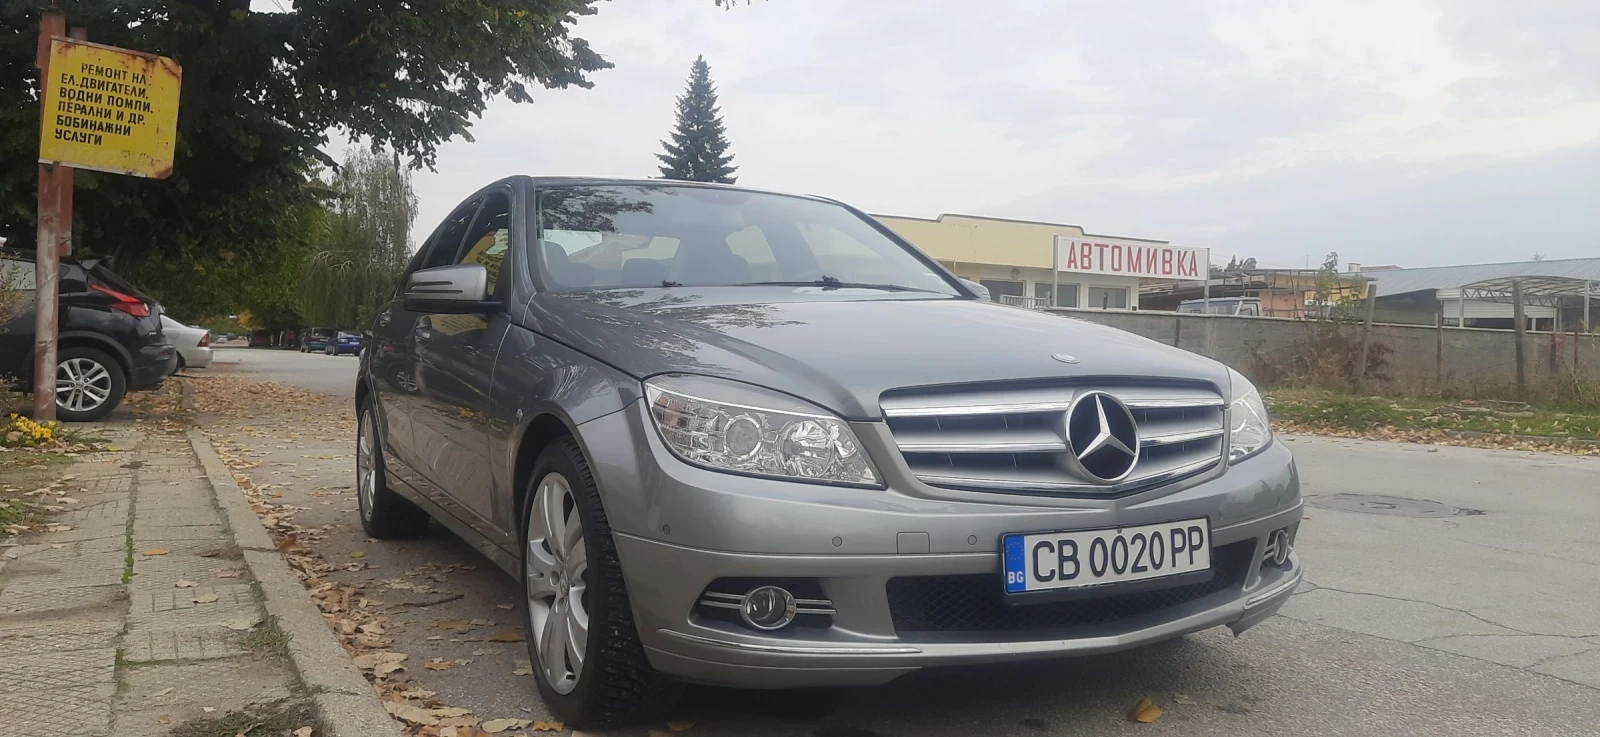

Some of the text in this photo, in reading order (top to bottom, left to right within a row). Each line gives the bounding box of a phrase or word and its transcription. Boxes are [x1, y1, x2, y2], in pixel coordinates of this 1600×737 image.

[81, 62, 128, 81] РЕМОНТ
[59, 87, 103, 104] ВОДНИ
[58, 101, 145, 125] ПЕРАЛНИ И ДР.
[56, 114, 131, 136] БОБИНАЖНИ
[55, 128, 103, 146] УСЛУГИ
[1067, 241, 1198, 277] АВТОМИВКА
[1089, 530, 1165, 578] 0020
[1008, 571, 1024, 584] BG
